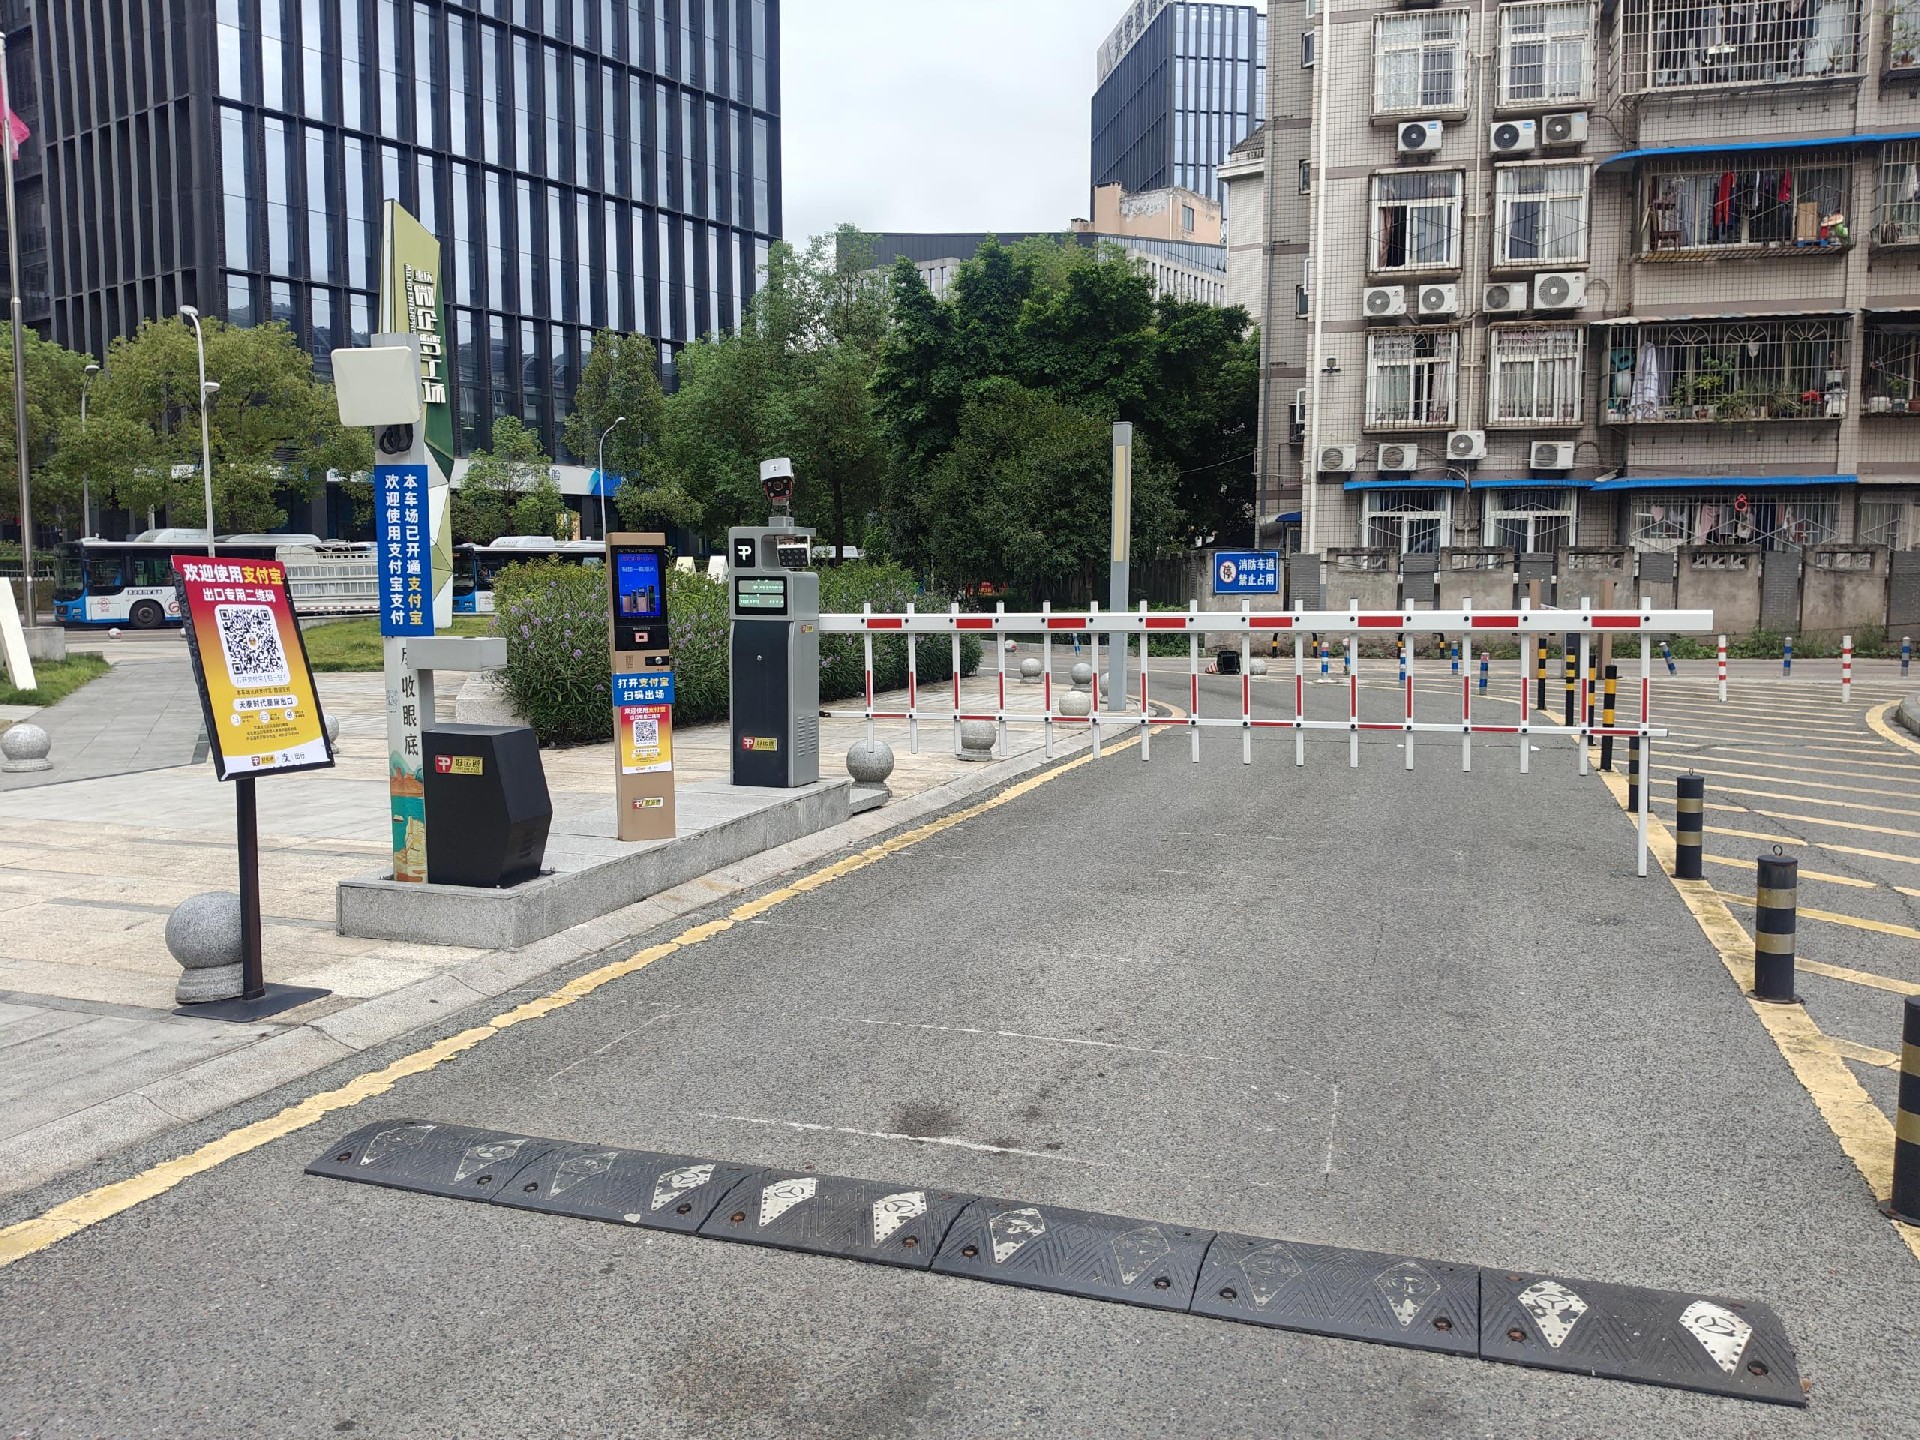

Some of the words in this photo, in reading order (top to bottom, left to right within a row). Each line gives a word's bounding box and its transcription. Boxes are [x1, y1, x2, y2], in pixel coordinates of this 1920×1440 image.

[385, 474, 405, 625] 欢迎使用支付宝支付
[403, 474, 424, 625] 本车场已开通支付宝
[1238, 558, 1276, 571] 消防车道
[182, 563, 284, 585] 欢迎使用支付宝
[1238, 573, 1276, 586] 禁止占用
[202, 587, 277, 603] 出口专用二维码
[617, 677, 670, 689] 打开支付宝
[623, 690, 665, 701] 扫码出场
